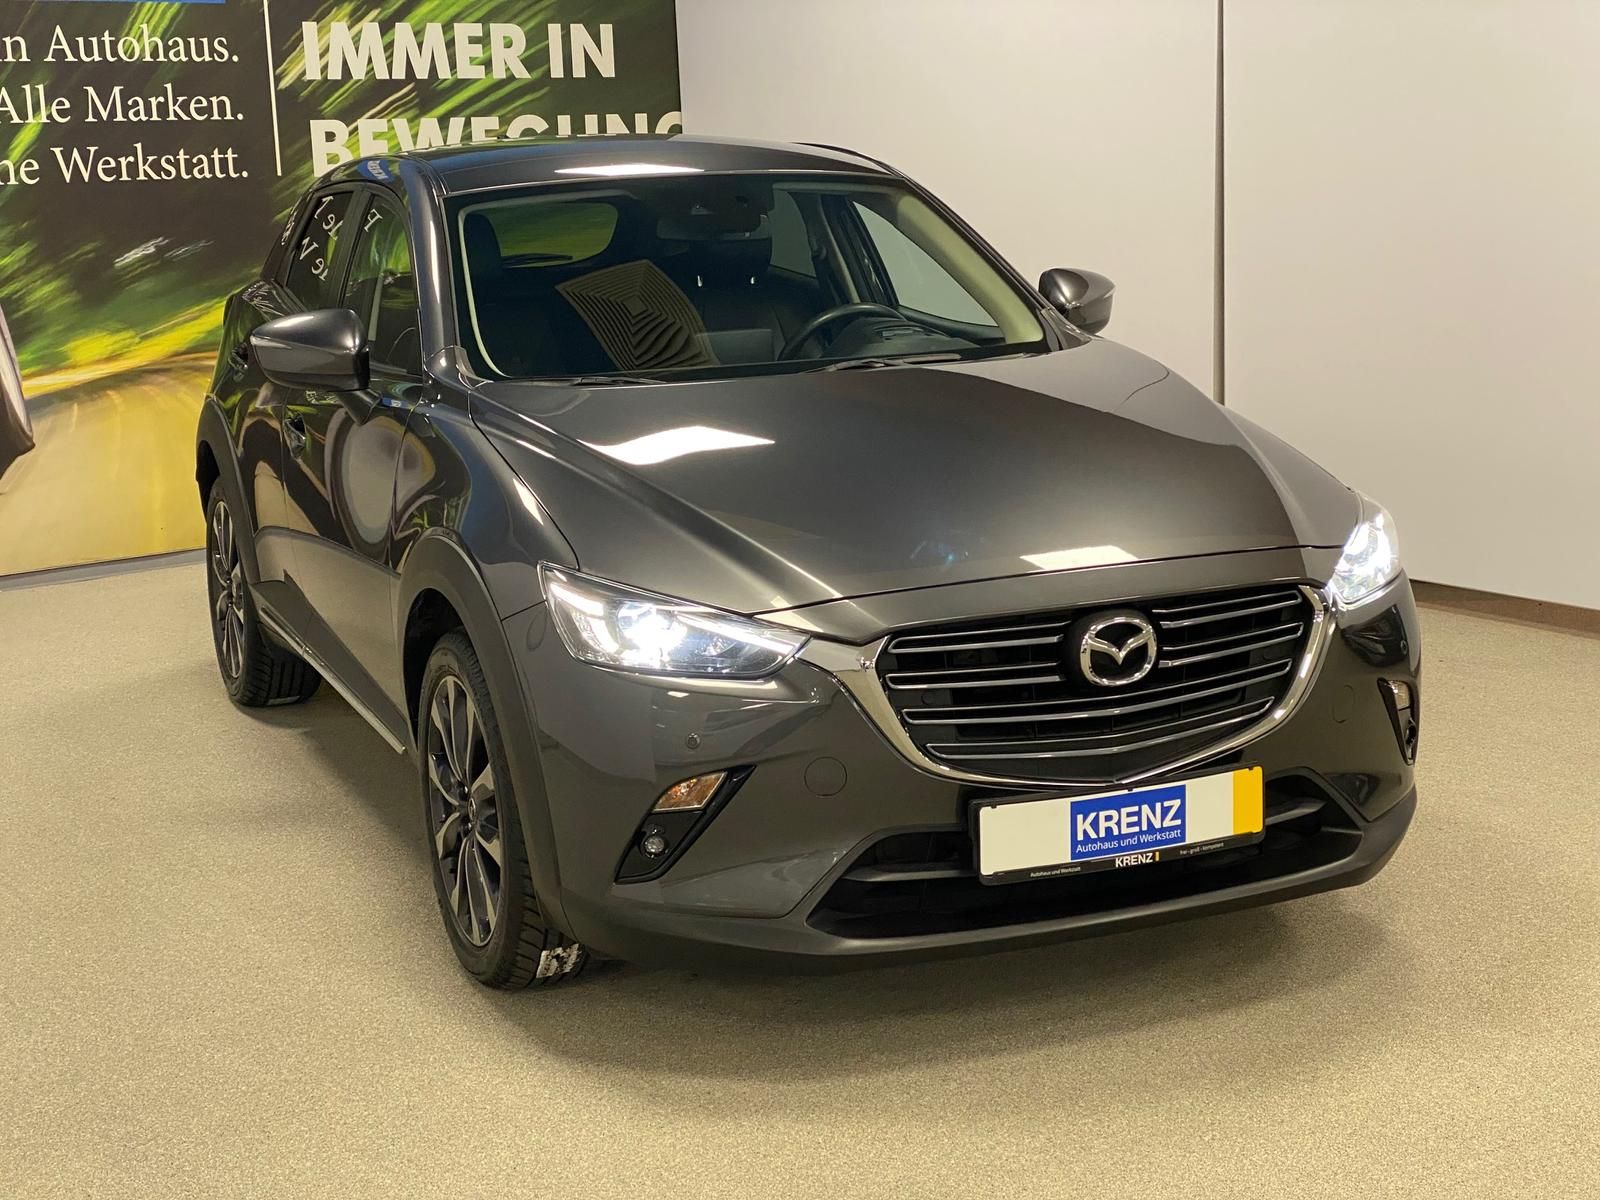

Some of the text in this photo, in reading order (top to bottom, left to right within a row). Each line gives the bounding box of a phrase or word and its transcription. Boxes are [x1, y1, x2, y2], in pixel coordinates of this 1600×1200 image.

[0, 23, 239, 62] n Autohaus.
[302, 21, 616, 80] IMMER IN
[0, 83, 244, 124] Alle Marken.
[50, 142, 249, 184] Werkstatt.
[1076, 799, 1182, 841] KRENZ
[1076, 829, 1181, 854] Autohaus und Werkstatt
[1115, 852, 1153, 868] KRENZ
